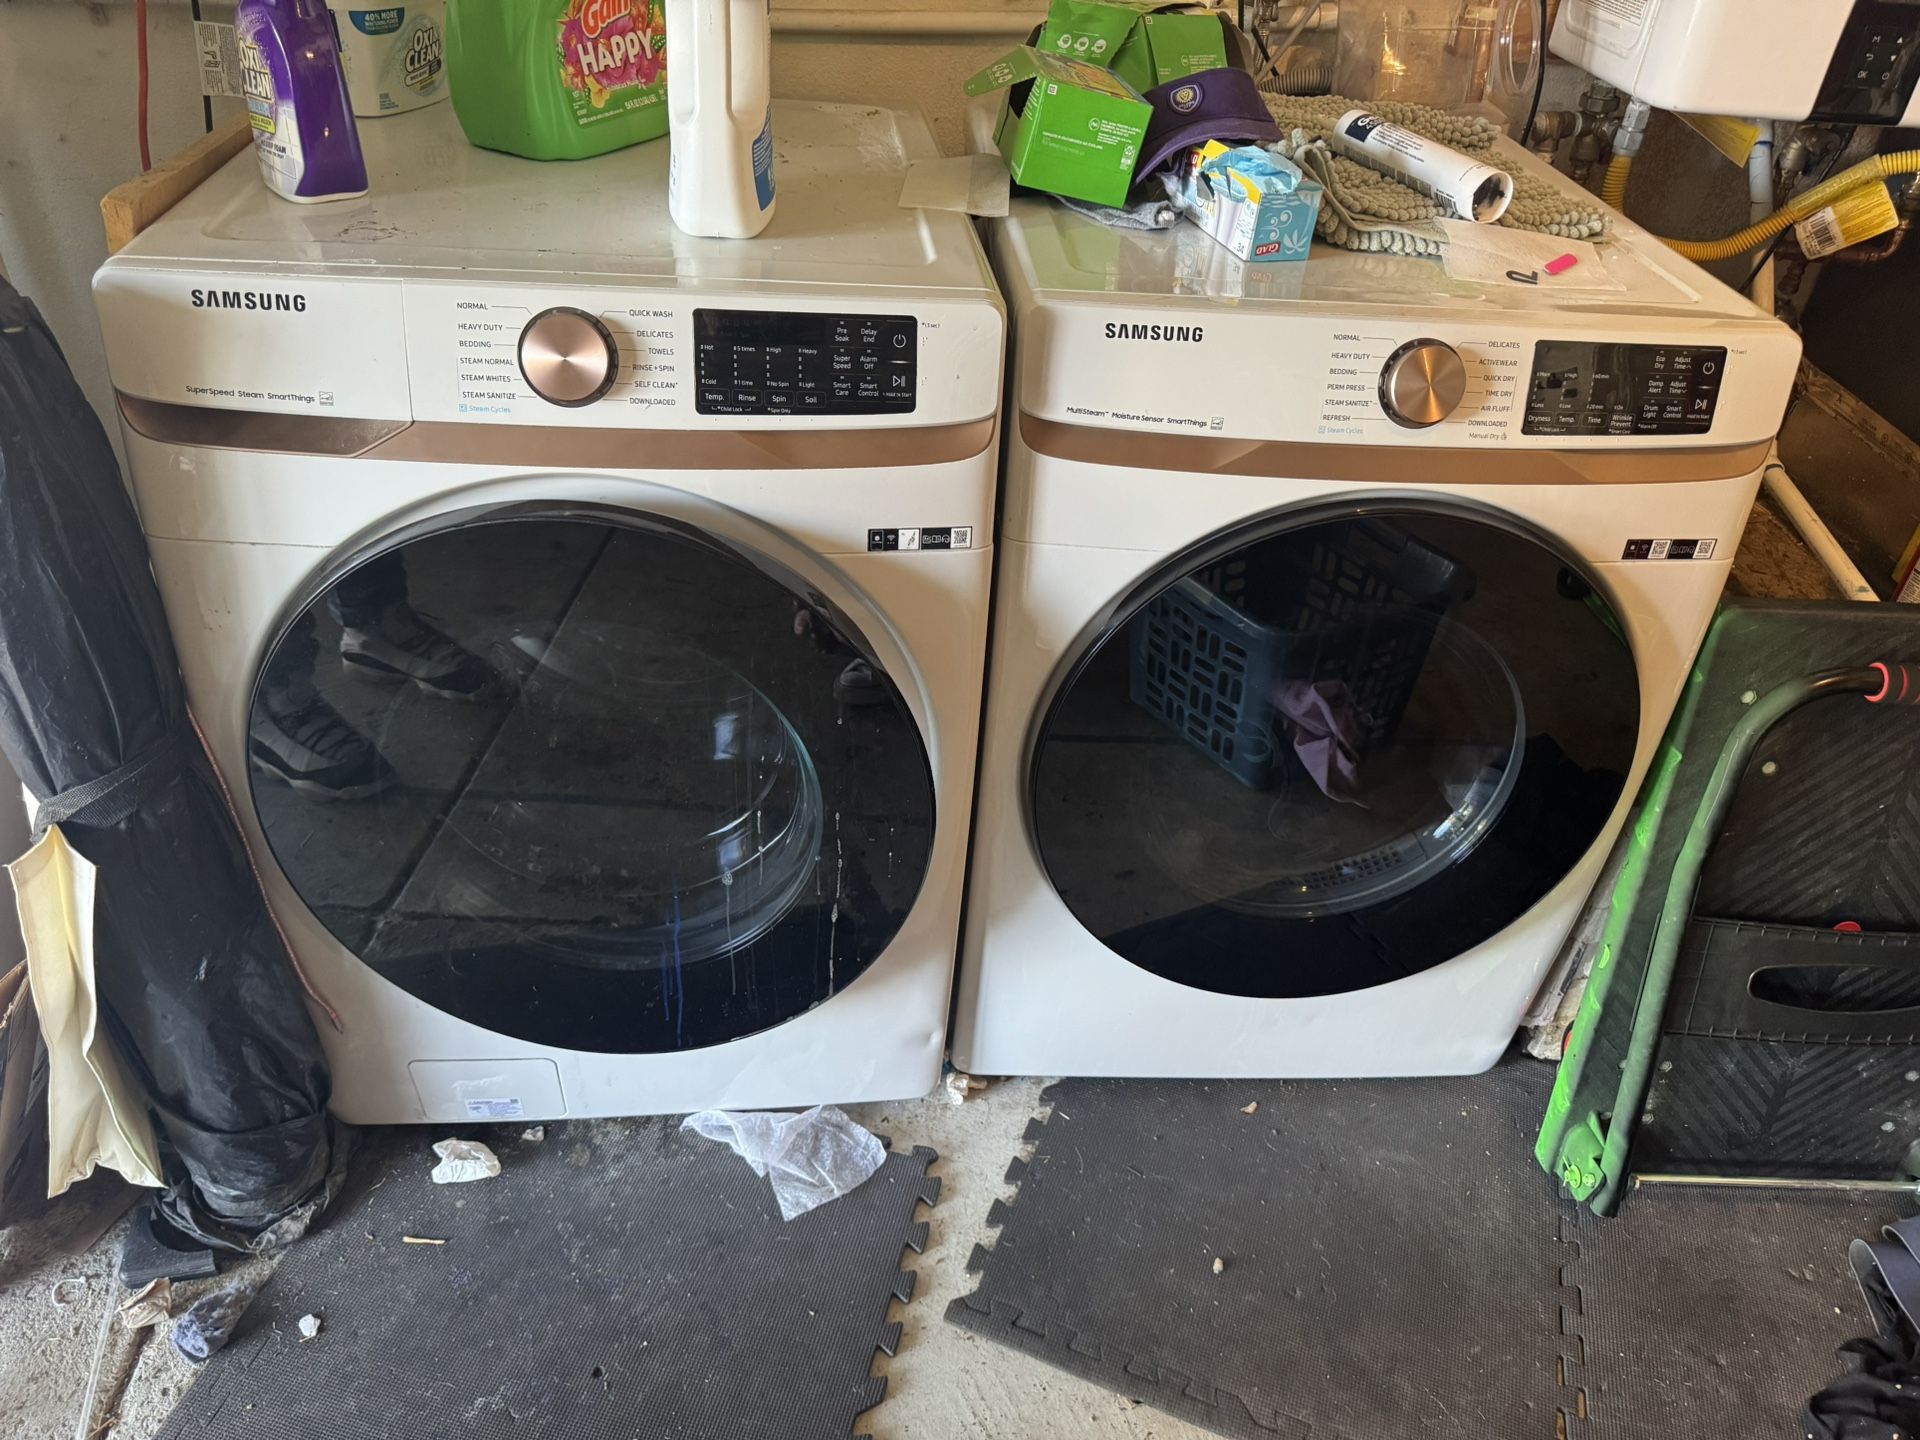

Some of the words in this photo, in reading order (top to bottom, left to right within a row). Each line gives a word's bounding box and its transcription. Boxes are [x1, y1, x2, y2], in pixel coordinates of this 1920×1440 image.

[364, 12, 381, 22] 40%
[413, 26, 434, 52] OXI
[238, 36, 260, 72] OXI
[405, 39, 441, 74] CLEAN
[576, 28, 653, 76] HAPPY
[1256, 242, 1279, 256] GLAD
[190, 288, 307, 312] SAMSUNG
[456, 302, 489, 311] NORMAL
[628, 309, 651, 318] QUICK
[652, 310, 673, 318] WASH
[457, 322, 482, 331] HEAVY
[483, 323, 503, 332] DUTY
[636, 330, 674, 339] DELICATES
[1105, 322, 1204, 343] SAMSUNG
[1333, 334, 1361, 342] NORMAL
[458, 340, 492, 349] BEDDING
[1488, 341, 1521, 349] DELICATES
[648, 347, 674, 356] TOWELS
[1331, 352, 1352, 360] HEAVY
[459, 357, 484, 365] STEAM
[483, 357, 514, 366] NORMAL
[1478, 359, 1518, 367] ACTIVEWEAR
[632, 363, 653, 372] RINSE
[658, 365, 675, 373] SPIN
[1329, 368, 1358, 376] BEDDING
[460, 374, 484, 382] STEAM
[484, 374, 511, 383] WHITES
[1482, 375, 1501, 383] QUICK
[1502, 375, 1516, 383] DRY
[185, 385, 235, 398] SuperSpeed
[237, 389, 265, 400] Steam
[267, 391, 315, 404] SmartThings
[486, 391, 517, 400] SANITIZE
[704, 393, 725, 401] Temp.
[738, 394, 756, 402] Rinse
[629, 397, 676, 406] DOWNLOADED
[772, 395, 787, 404] Spin
[805, 396, 818, 404] Soil
[468, 404, 489, 413] Steam
[489, 405, 512, 414] Cycles
[1111, 411, 1141, 422] Moisture
[1141, 414, 1164, 424] Sensor
[1166, 417, 1208, 428] SmartThings
[1467, 419, 1508, 428] DOWNLOADED
[1468, 432, 1489, 440] Manual
[1489, 432, 1500, 441] Dry
